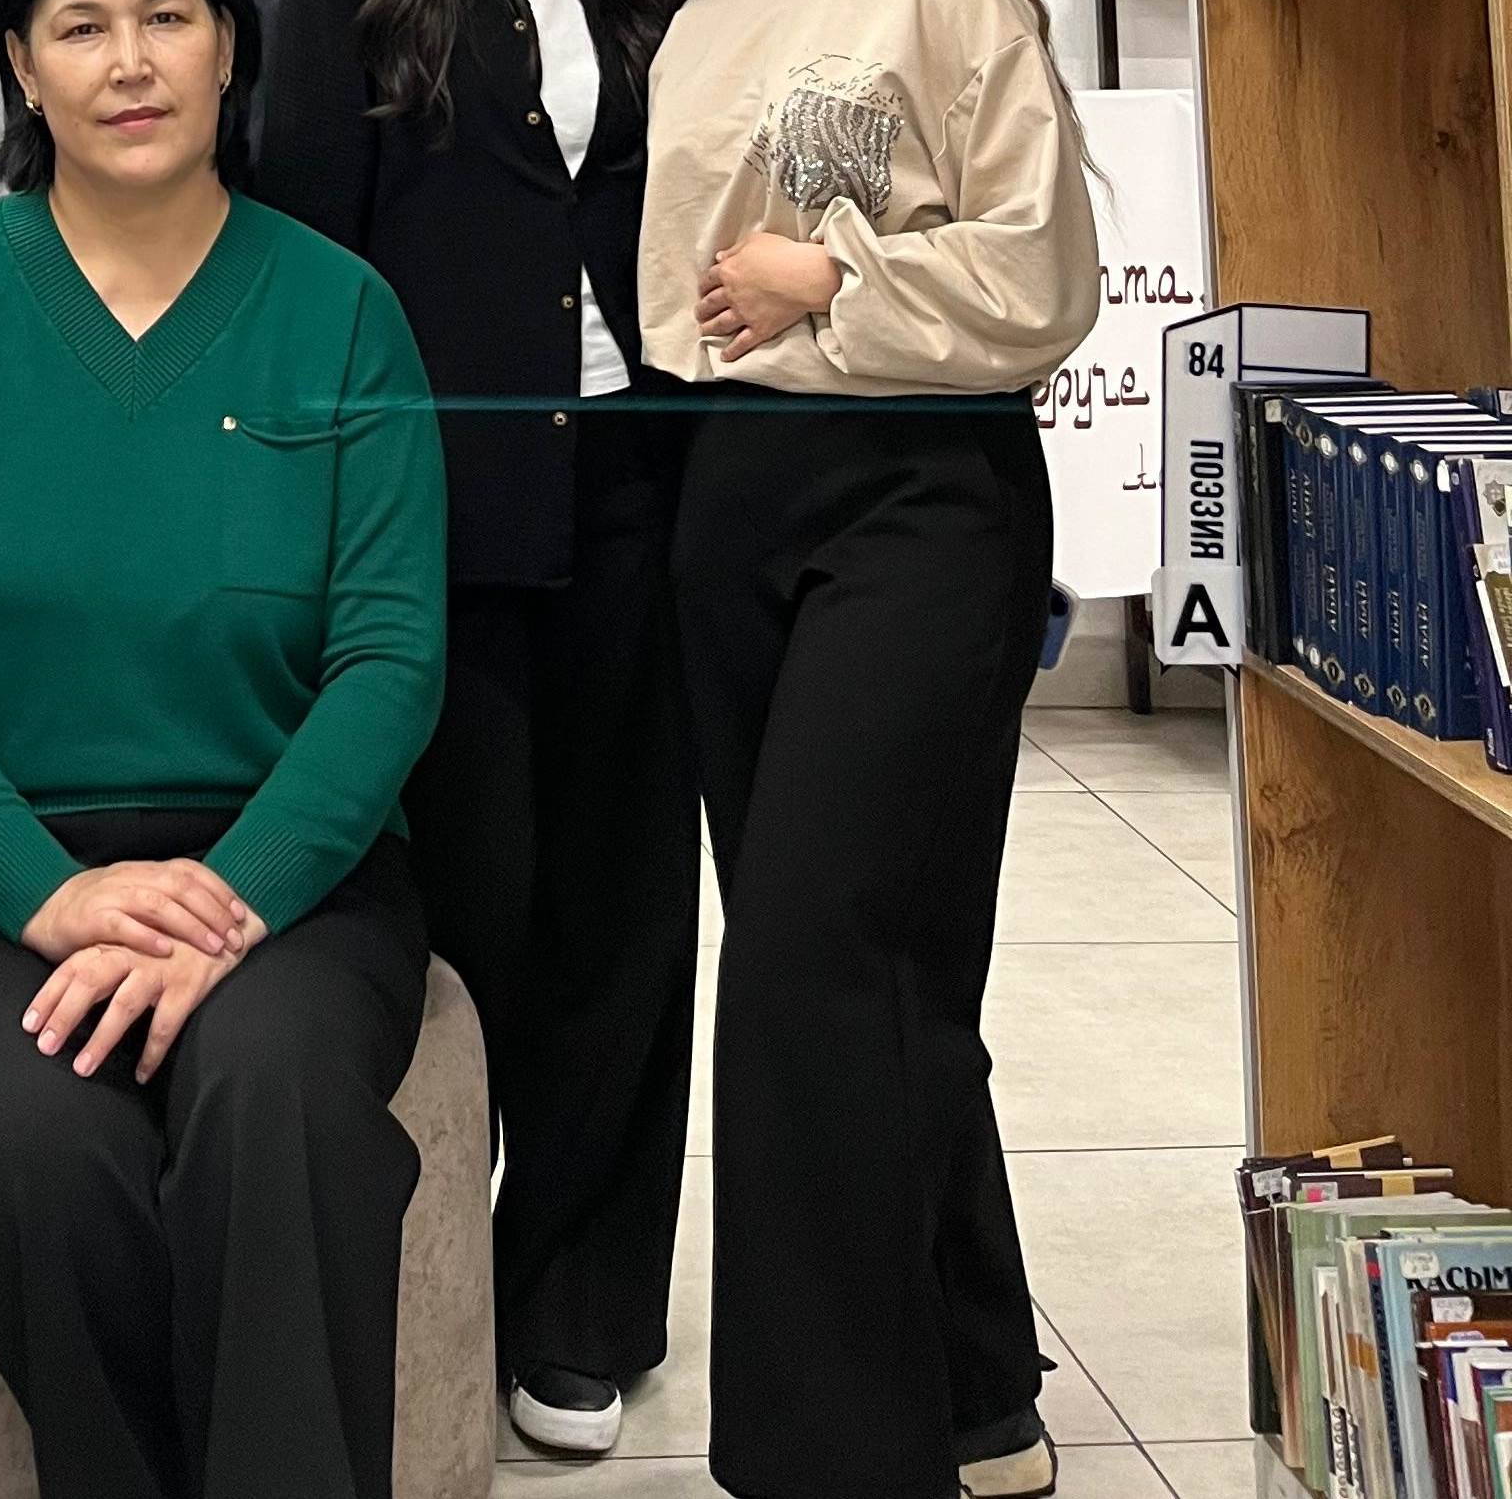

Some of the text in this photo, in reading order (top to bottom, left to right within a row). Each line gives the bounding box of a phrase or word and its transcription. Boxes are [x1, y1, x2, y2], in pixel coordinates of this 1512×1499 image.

[1188, 341, 1226, 379] 84
[1190, 439, 1225, 560] ПОЭЗИЯ
[1170, 583, 1231, 647] А
